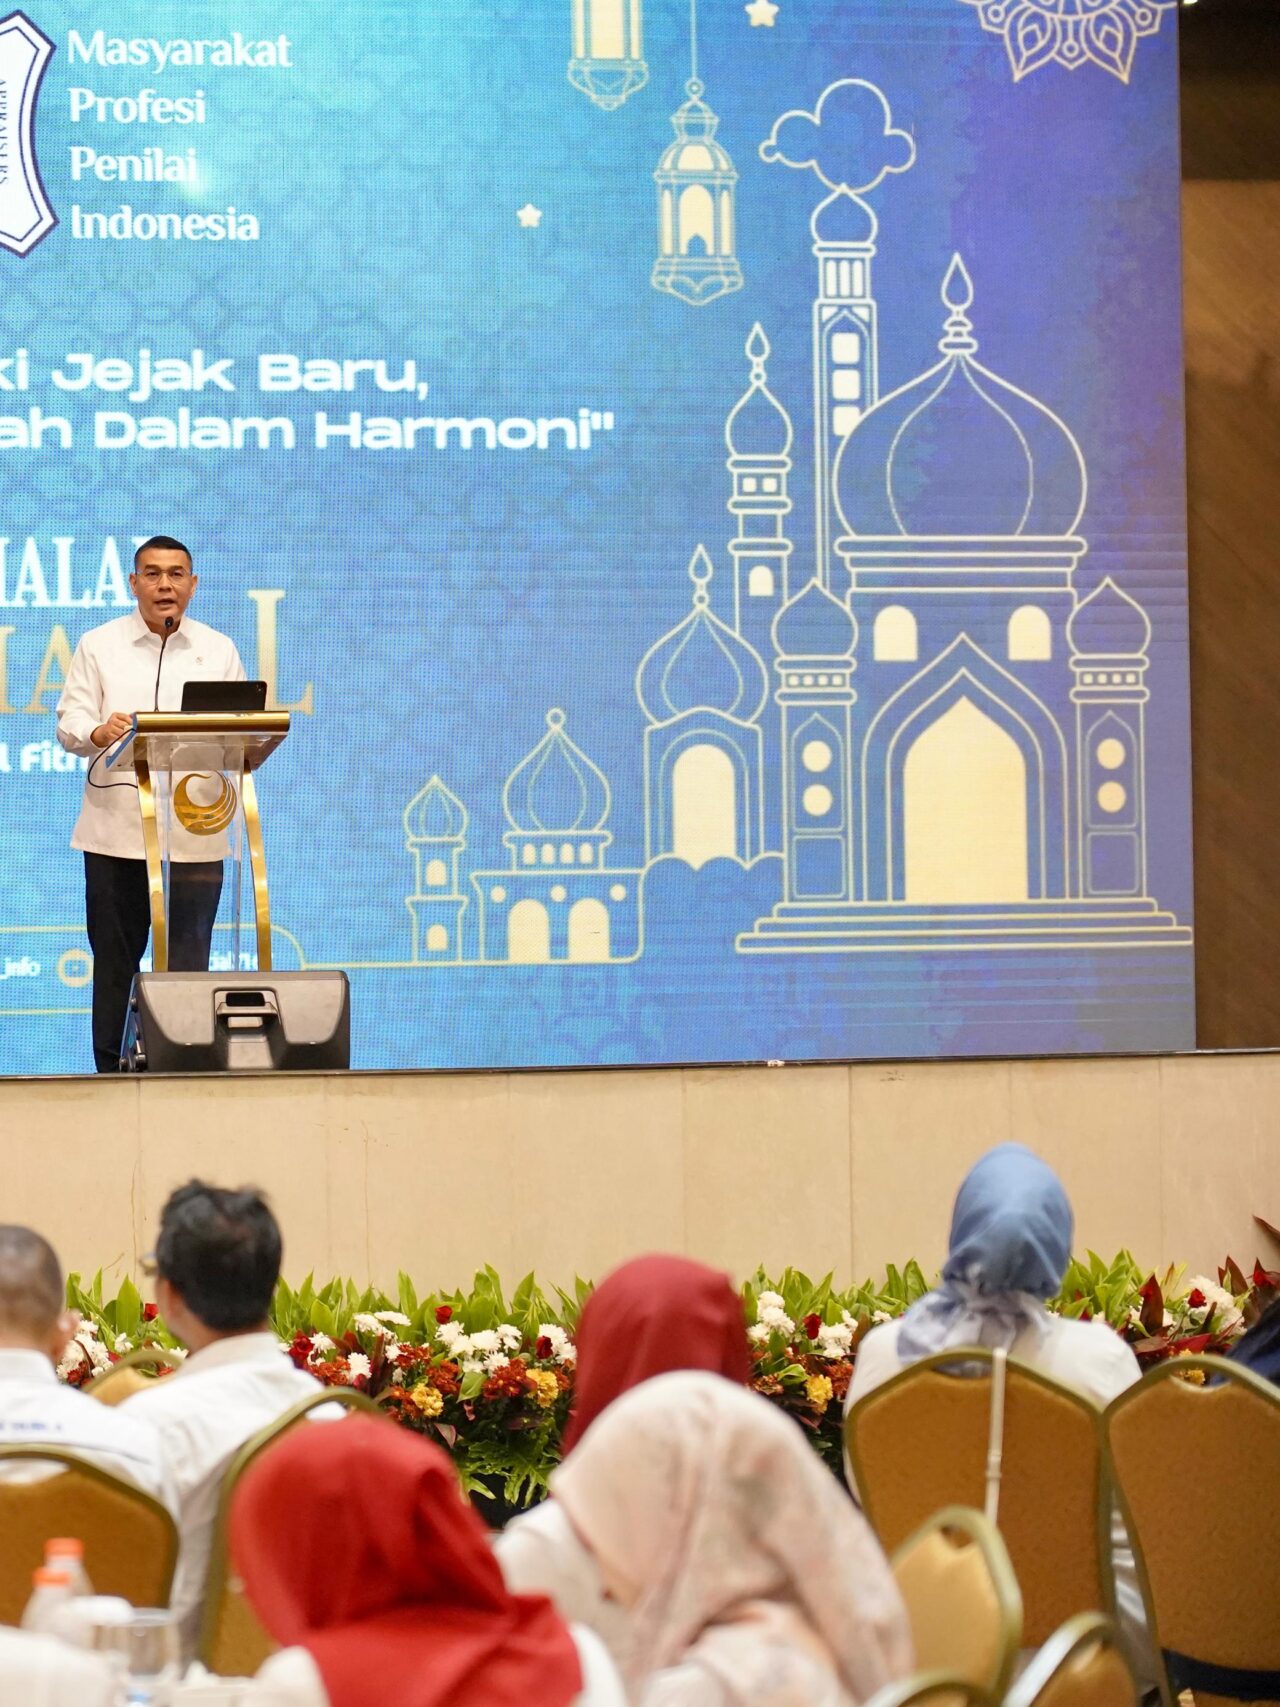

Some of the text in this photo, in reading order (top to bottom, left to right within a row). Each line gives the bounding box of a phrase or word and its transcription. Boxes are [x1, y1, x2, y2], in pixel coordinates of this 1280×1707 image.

[68, 30, 293, 74] Masyarakat
[68, 87, 206, 124] Profesi
[69, 146, 197, 182] Penilai
[71, 204, 260, 241] Indonesia
[51, 348, 235, 402] Jejak
[258, 353, 429, 400] Baru,
[94, 407, 295, 449] Dalam
[315, 407, 615, 449] Harmoni"
